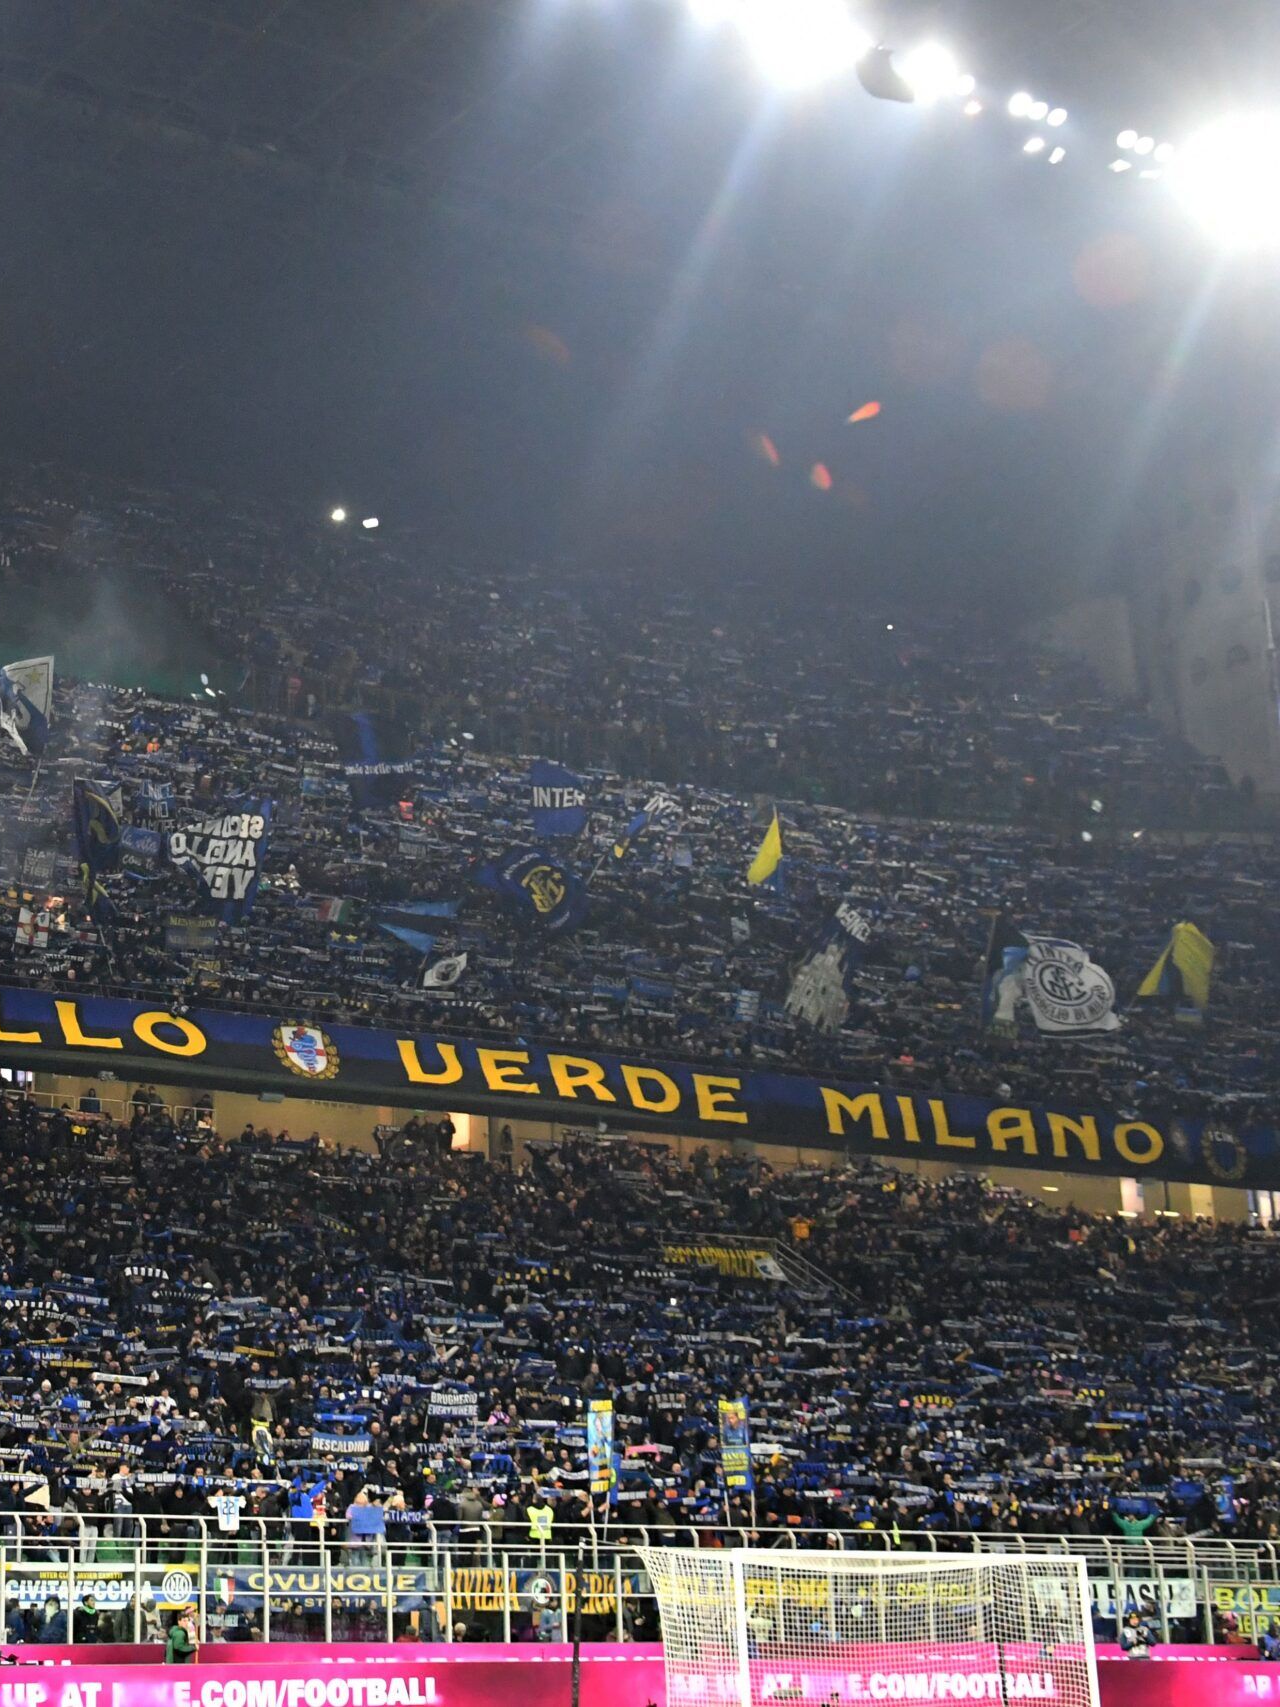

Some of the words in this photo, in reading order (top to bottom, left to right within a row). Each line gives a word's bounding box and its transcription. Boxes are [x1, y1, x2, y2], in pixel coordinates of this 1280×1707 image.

[533, 786, 585, 808] INTER
[819, 1087, 1165, 1164] MILANO
[427, 1403, 478, 1416] EVERYWHERE
[312, 1437, 370, 1453] RESCALDINA
[427, 1443, 448, 1452] AMO
[215, 1479, 236, 1487] AMO
[223, 1502, 234, 1515] 22
[400, 1511, 422, 1523] AMO
[5, 1579, 154, 1602] CIVITAVECCHA
[248, 1573, 418, 1591] OVUNQUE
[449, 1568, 520, 1611] RIVIERA
[3, 1682, 43, 1707] UP
[53, 1682, 101, 1707] AT
